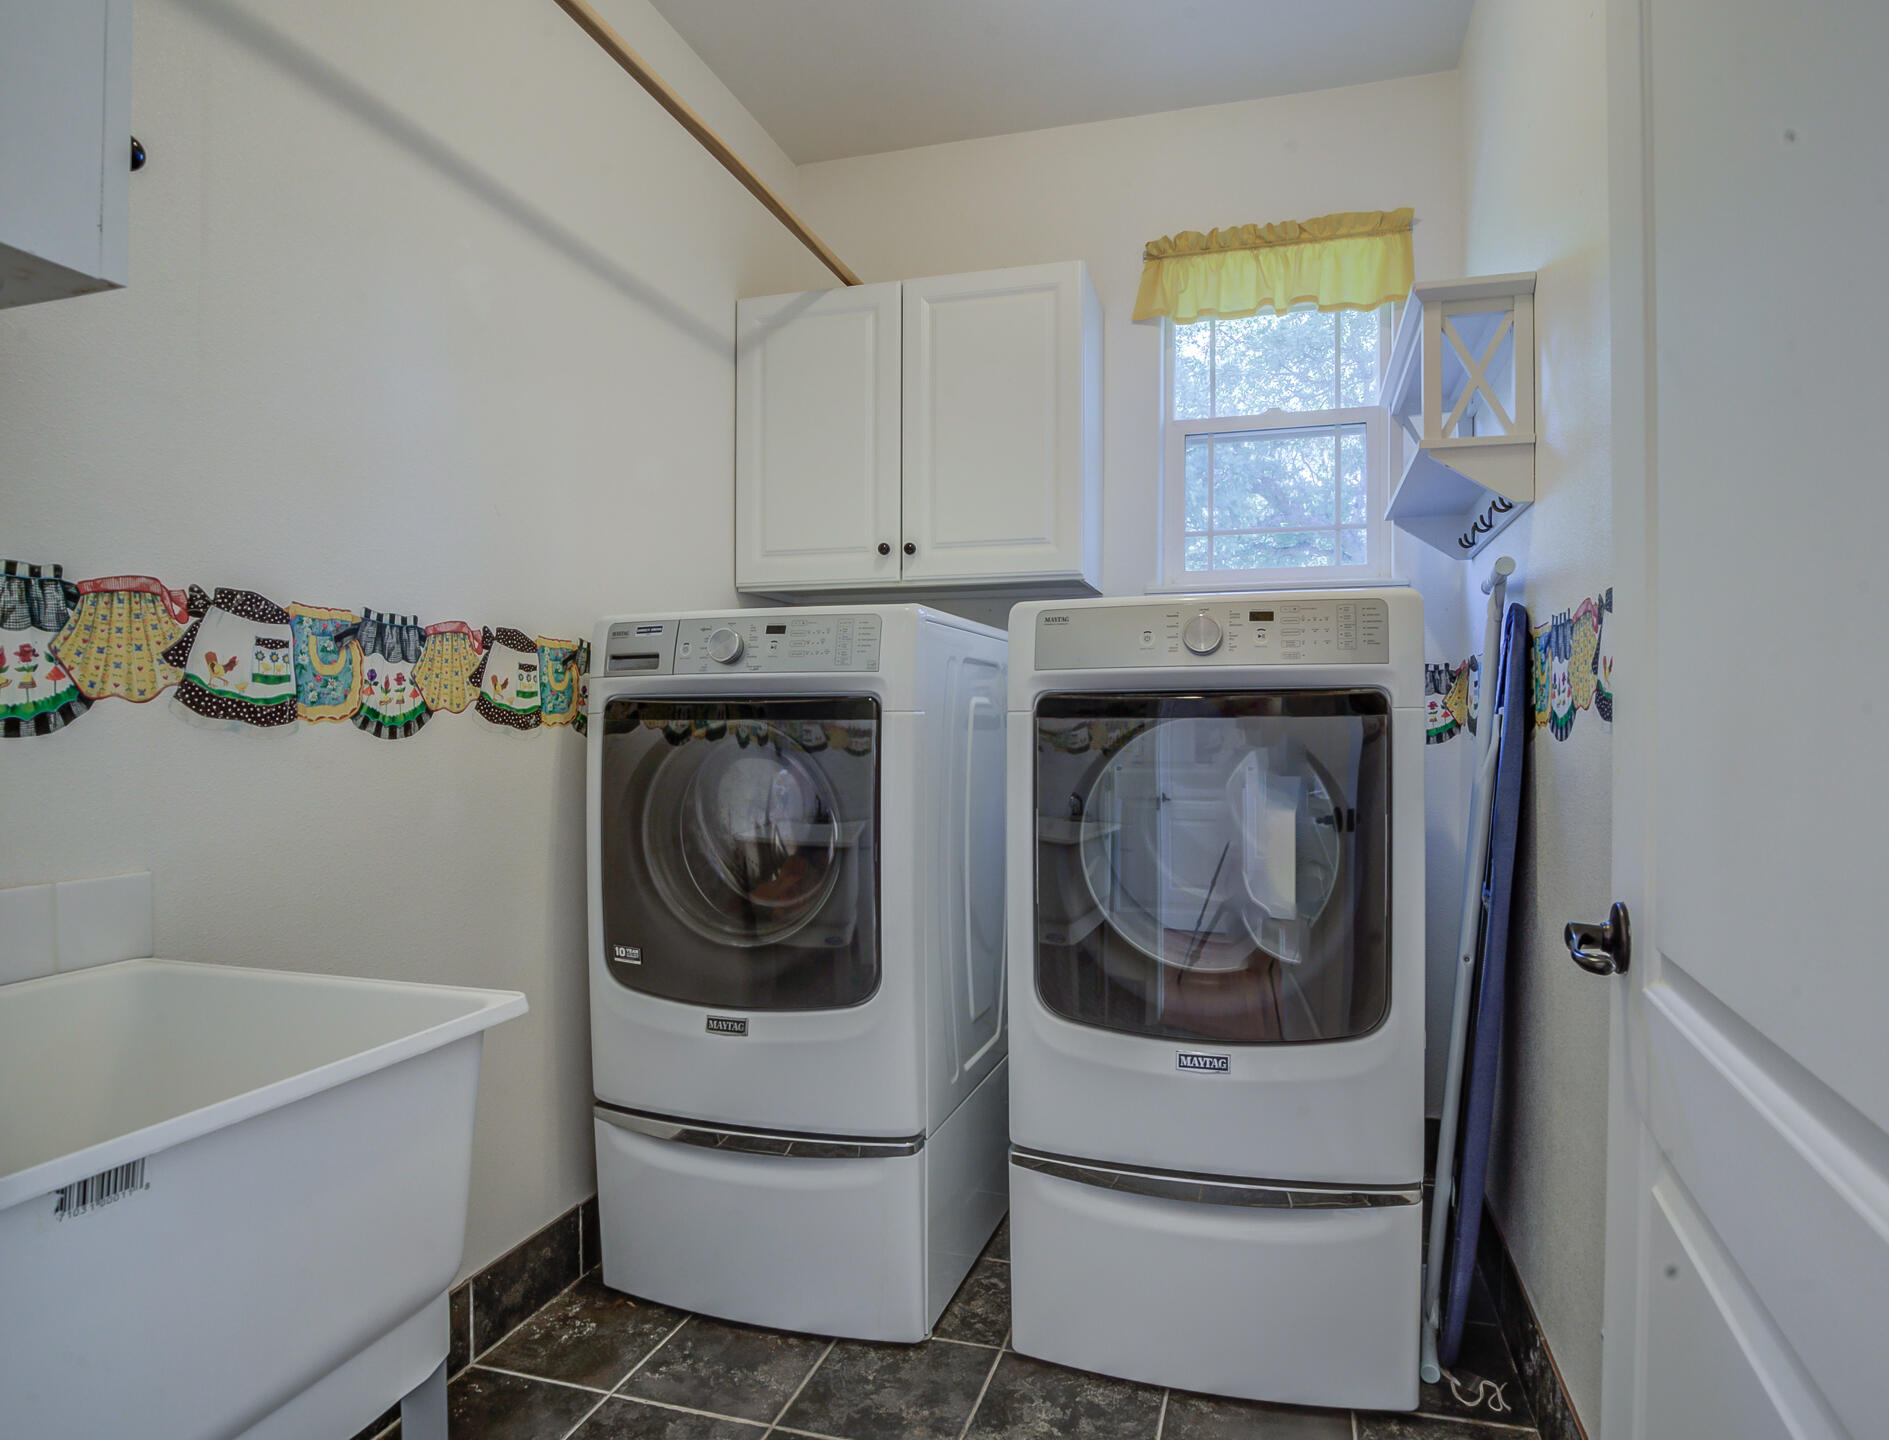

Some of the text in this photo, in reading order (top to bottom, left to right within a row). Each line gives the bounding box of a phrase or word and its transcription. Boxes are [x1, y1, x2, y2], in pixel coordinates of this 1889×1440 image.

[615, 946, 626, 957] 10
[708, 1019, 744, 1032] MAYTAG
[1180, 1056, 1227, 1069] MAYTAG
